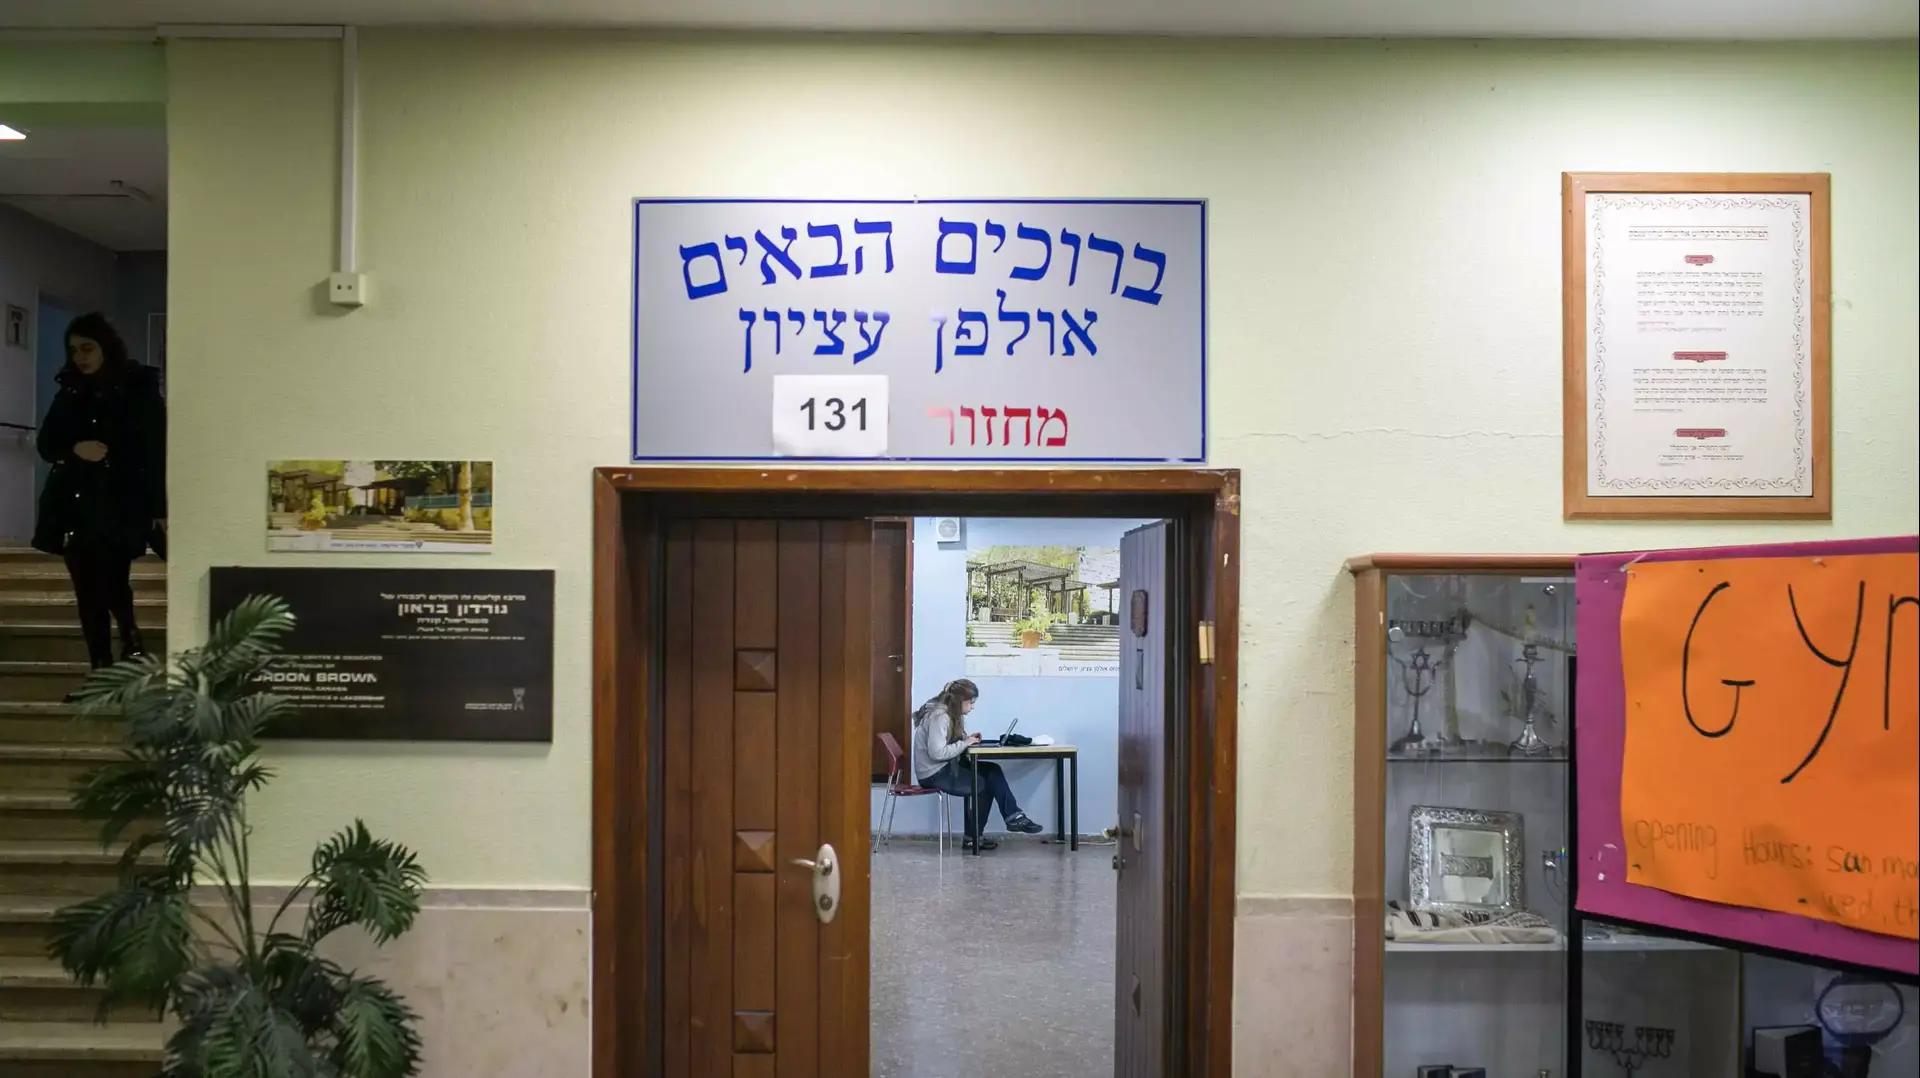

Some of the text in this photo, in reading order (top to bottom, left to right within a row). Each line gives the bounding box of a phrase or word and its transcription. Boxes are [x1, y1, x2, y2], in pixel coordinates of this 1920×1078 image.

[678, 217, 1167, 306] ברוכים הבאים
[738, 289, 1100, 374] אולפן עציון
[799, 396, 1070, 448] מחזור 131
[398, 603, 508, 617] גורדון בראון
[315, 672, 377, 683] BROWN
